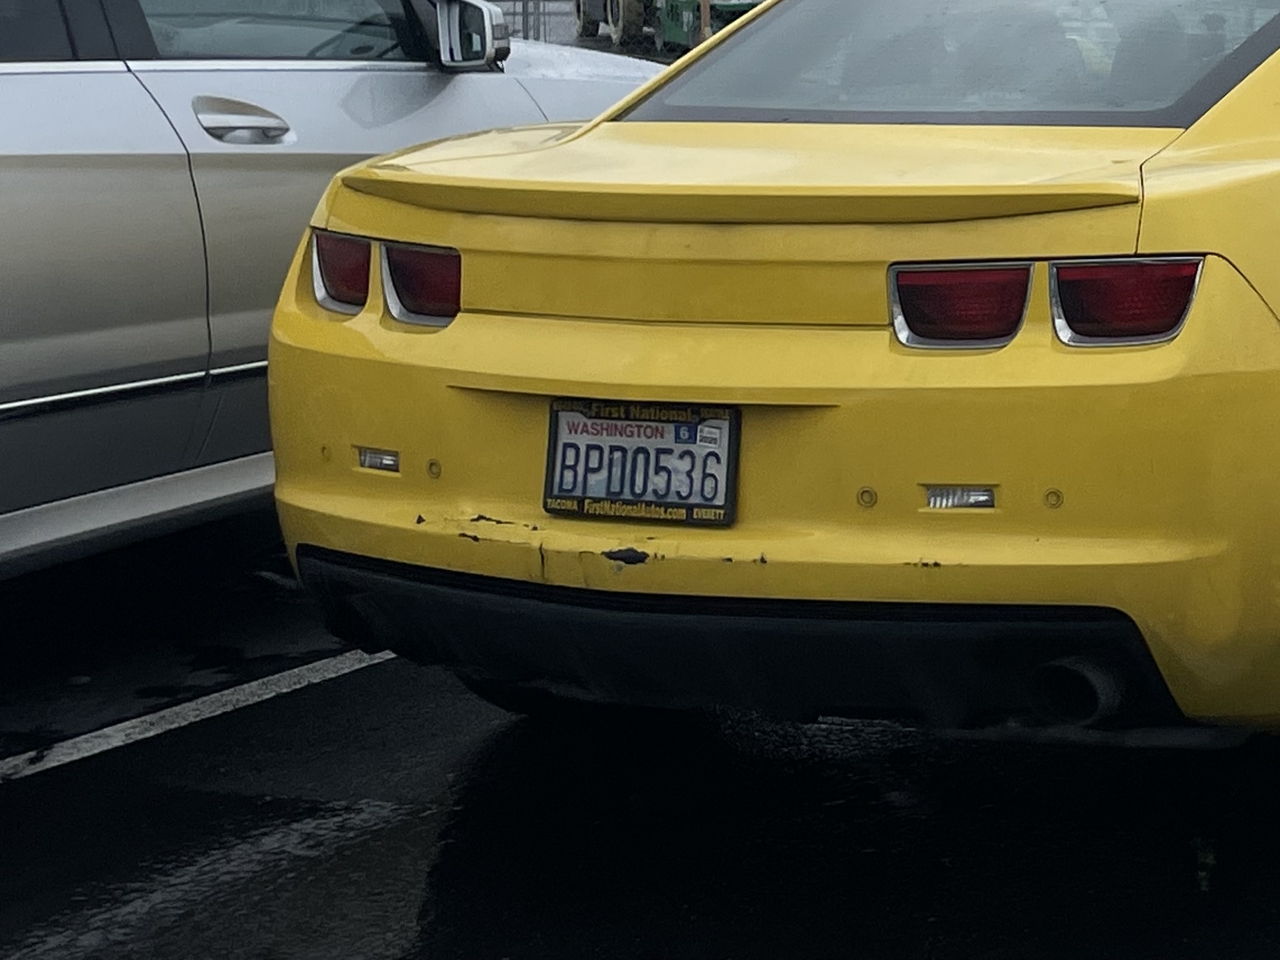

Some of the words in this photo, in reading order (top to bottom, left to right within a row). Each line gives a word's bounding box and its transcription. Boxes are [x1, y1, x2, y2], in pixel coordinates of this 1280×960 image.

[567, 421, 665, 440] WASHINGTON
[679, 427, 689, 439] 6
[558, 442, 722, 502] BPD0536
